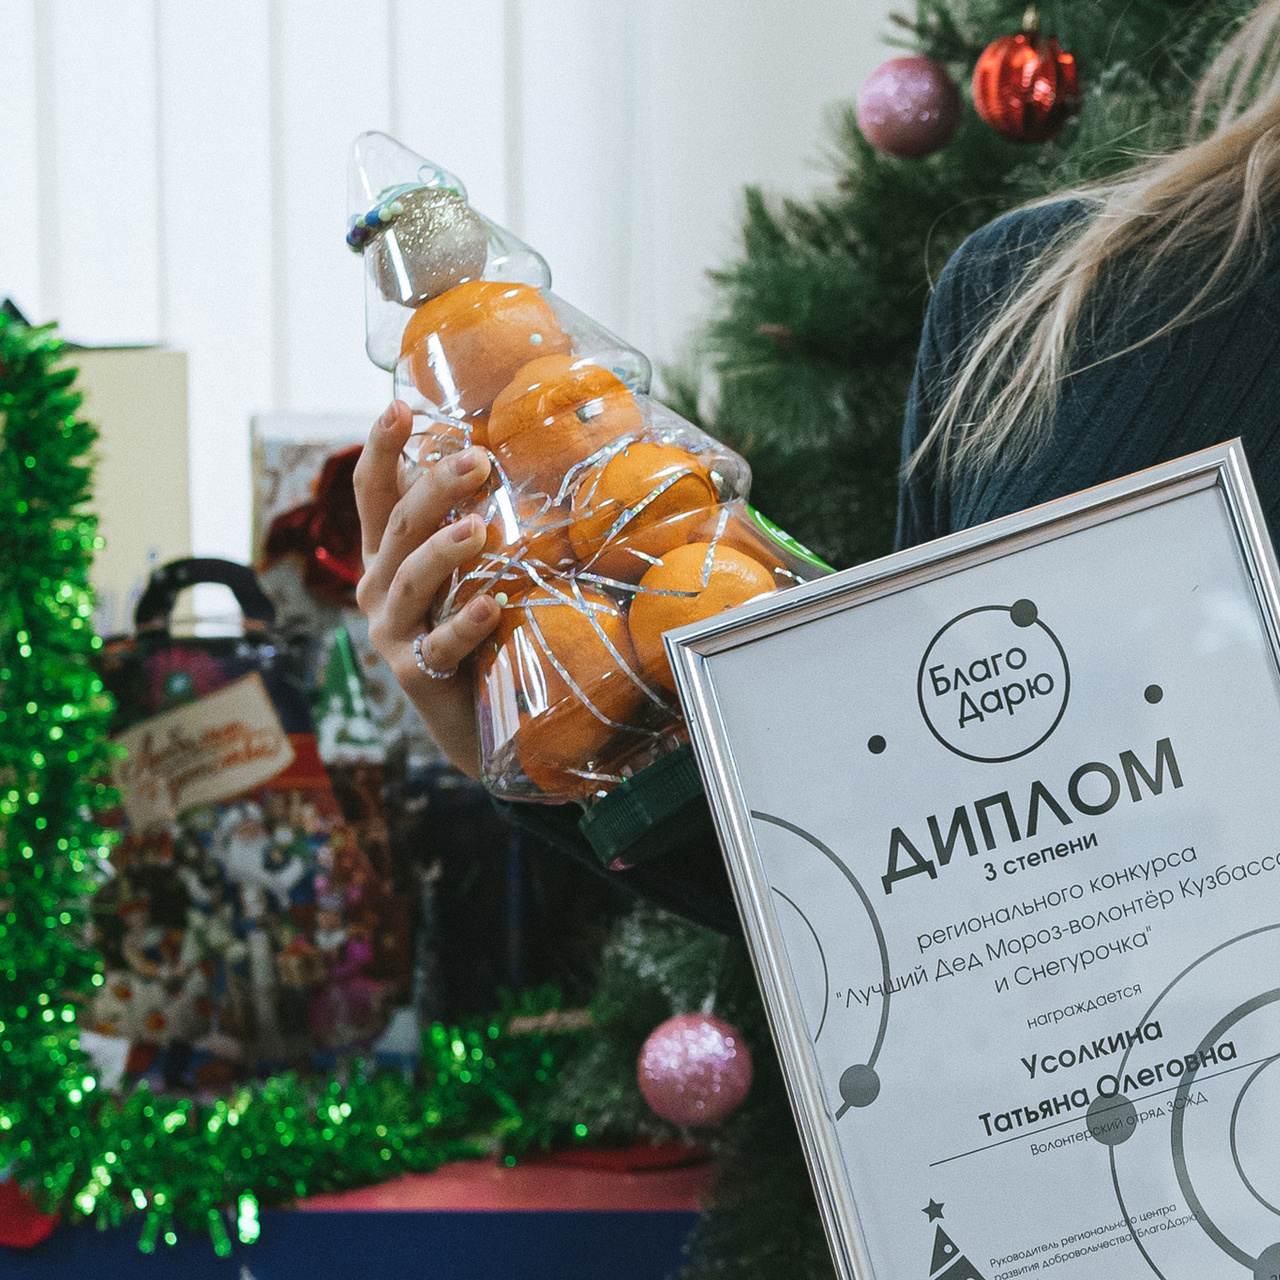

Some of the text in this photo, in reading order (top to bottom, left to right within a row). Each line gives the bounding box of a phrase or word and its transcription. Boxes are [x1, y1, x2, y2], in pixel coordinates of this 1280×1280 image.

[929, 646, 1028, 697] Благо
[958, 673, 1055, 728] Дарю
[880, 737, 1184, 894] ДИПЛОМ
[984, 832, 1098, 882] 3 степени
[916, 845, 1198, 953] регионального конкурса
[935, 950, 984, 982] Дед
[986, 885, 1176, 962] Мороз-волонтёр
[994, 926, 1154, 994] и Снегурочка"
[1026, 982, 1143, 1030] награждается
[1020, 1020, 1163, 1079] Усолкина
[978, 1040, 1238, 1138] Татьяна Олеговна
[1030, 1115, 1125, 1156] Волонтерский
[1125, 1106, 1166, 1127] отряд
[989, 1202, 1178, 1269] Руководитель региональноо центра
[1042, 1233, 1133, 1270] добровольчества
